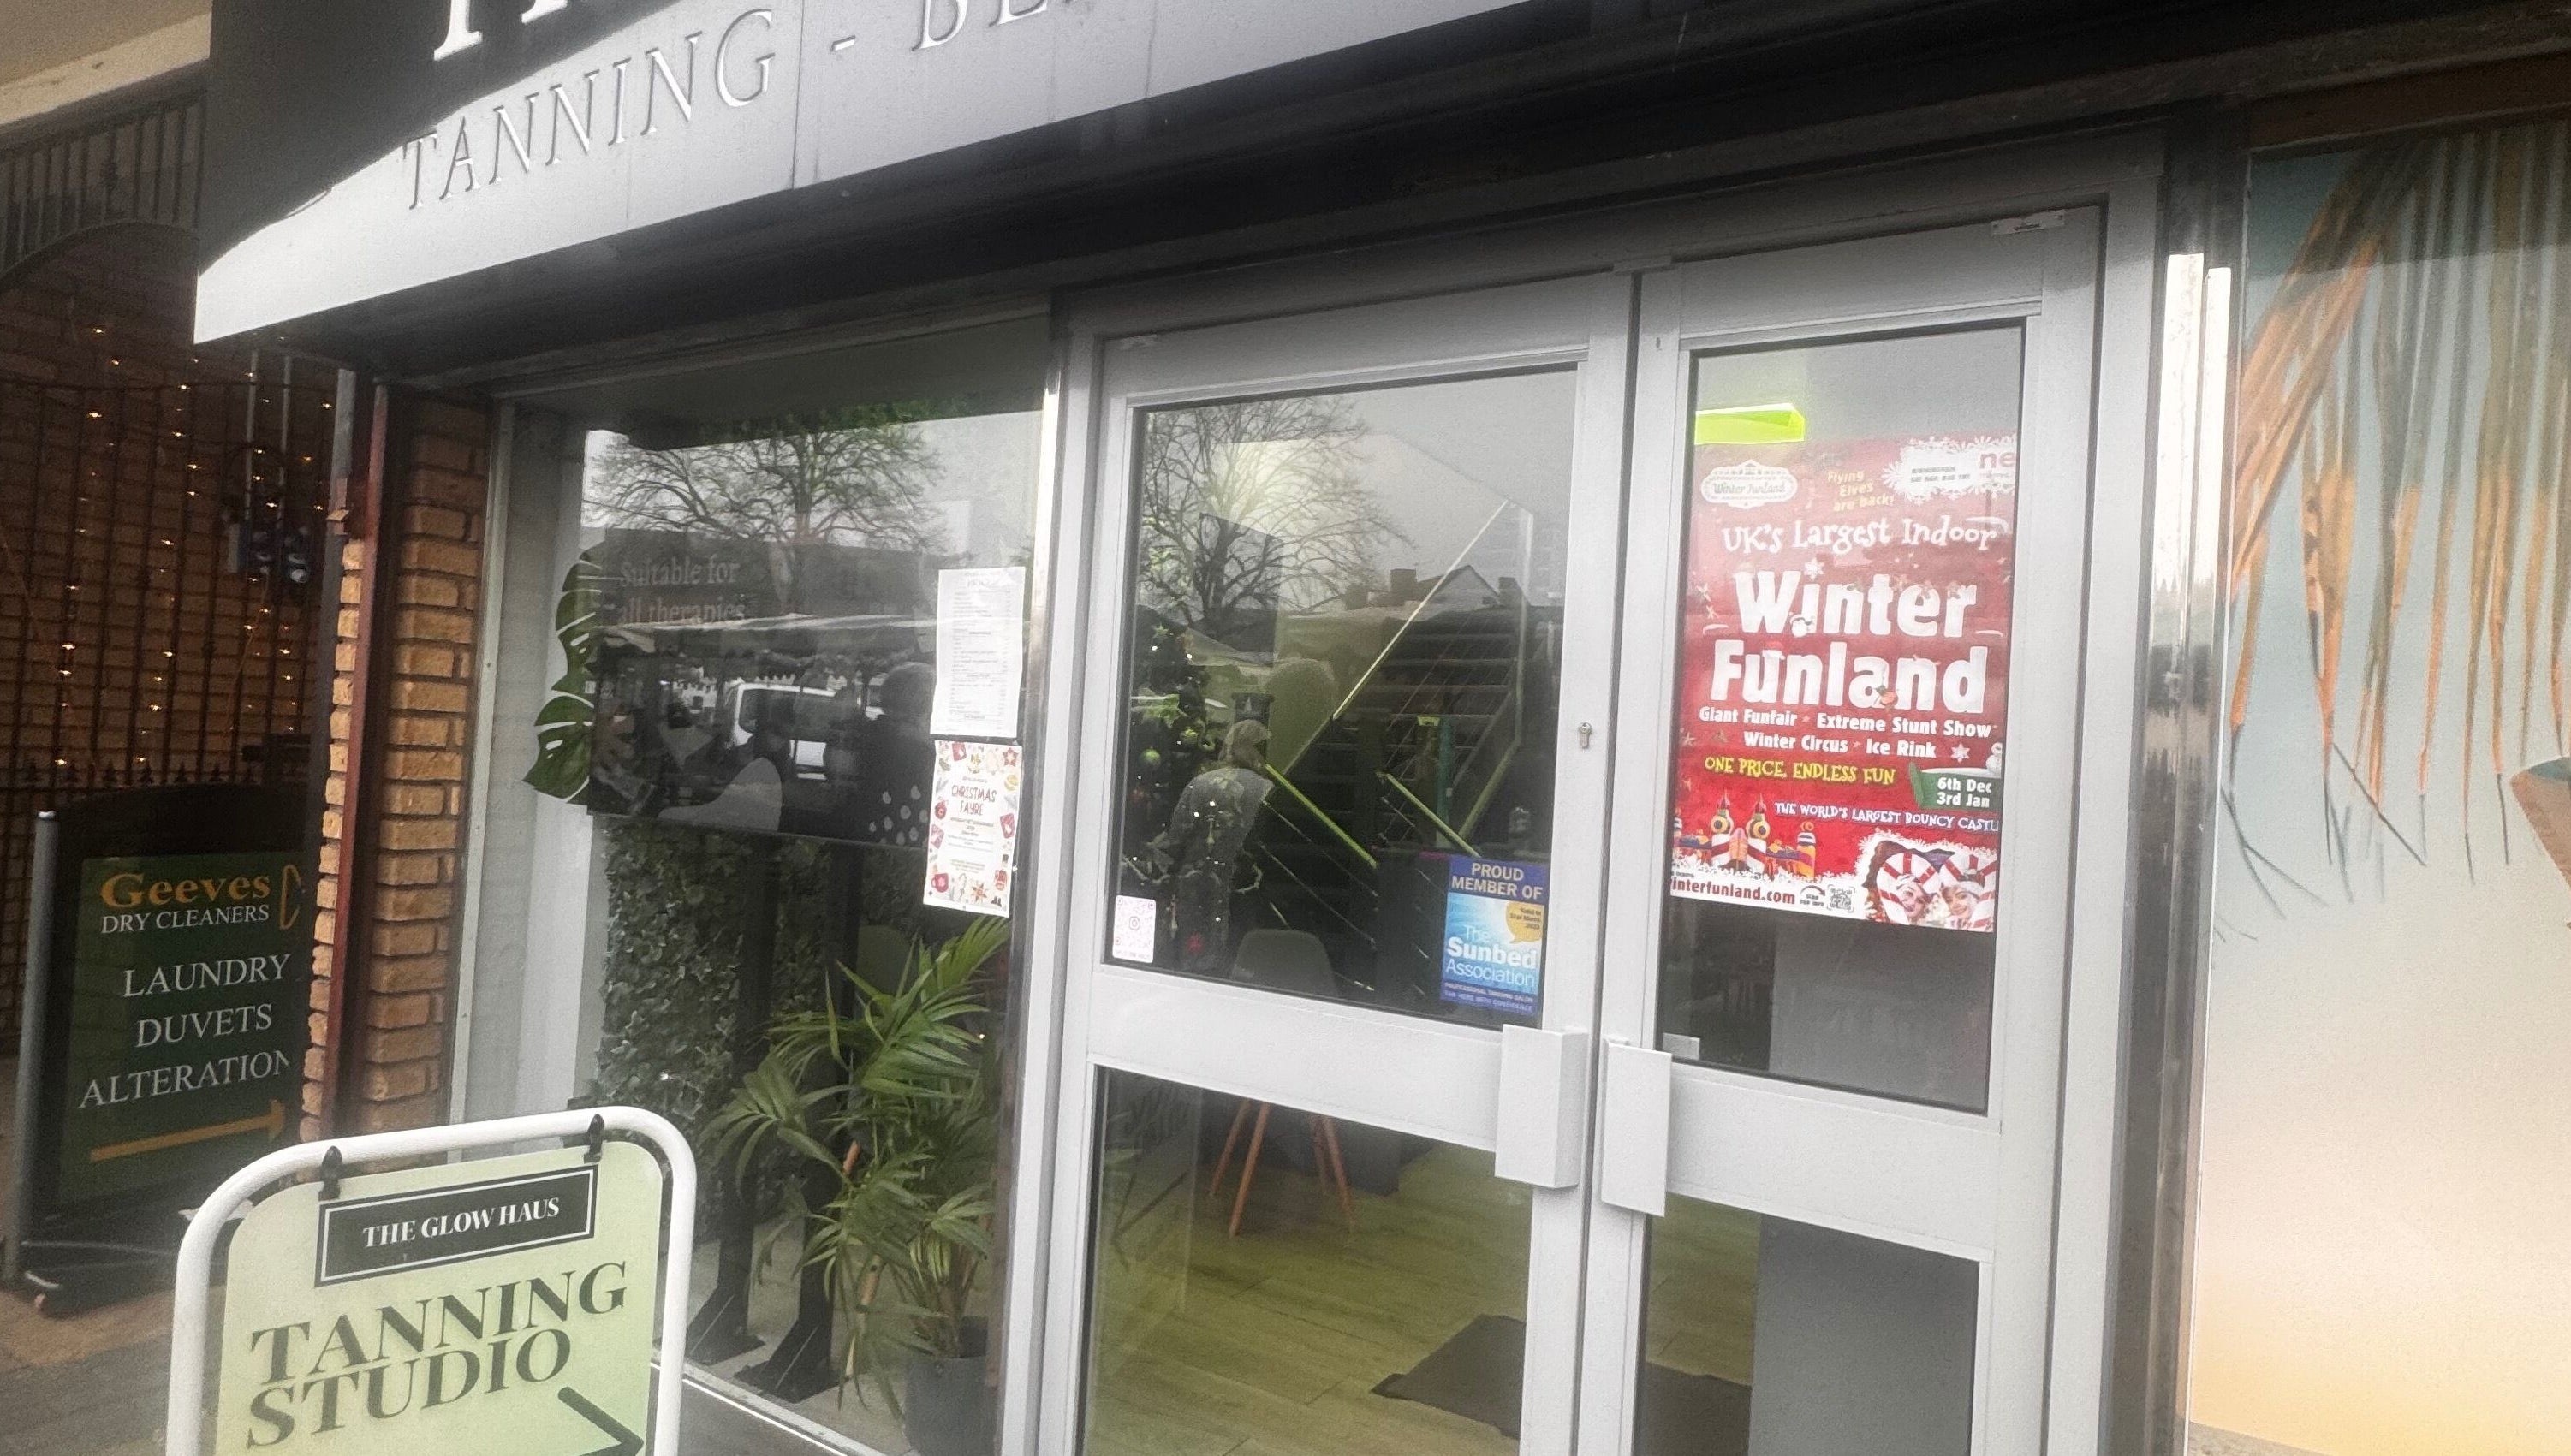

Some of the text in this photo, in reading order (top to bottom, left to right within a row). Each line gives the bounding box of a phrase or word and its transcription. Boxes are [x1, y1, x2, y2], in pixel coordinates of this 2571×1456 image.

[402, 8, 776, 211] TANNING
[1828, 471, 1865, 484] Flying
[1840, 482, 1873, 496] Elves
[1833, 494, 1894, 512] are back!
[1721, 514, 1997, 555] UK's Largest Indoor
[619, 553, 741, 586] Suitable for
[1733, 570, 1978, 639] Winter
[1710, 639, 1989, 714] Funland
[1699, 706, 1992, 738] Giant Funfair Extreme Stunt Show
[1744, 731, 1937, 758] Winter Circus Ice Rink
[1705, 757, 1735, 774] ONE
[1793, 762, 1858, 782] ENDLESS
[1862, 767, 1896, 785] FUN
[1937, 777, 1992, 793] 6th Dec
[951, 784, 997, 803] CHRISTMAS
[1937, 793, 1990, 807] 3rd Jan
[1775, 802, 1796, 815] THE
[1800, 804, 1848, 819] WORLD'S
[1852, 807, 1901, 823] LARGEST
[1905, 812, 1955, 829] BOUNCY
[1472, 862, 1524, 881] PROUD
[100, 871, 271, 908] Geeves
[1450, 875, 1544, 900] MEMBER OF
[101, 905, 270, 934] DRY CLEANERS
[1463, 924, 1490, 941] The
[1448, 937, 1537, 969] Sunbed
[122, 954, 291, 998] LAUNDRY
[1445, 959, 1535, 987] Association
[134, 1003, 273, 1048] DUVETS
[363, 1197, 561, 1248] THE GLOW HAUS
[251, 1261, 628, 1386] TANNING
[247, 1328, 572, 1449] STUDIO
